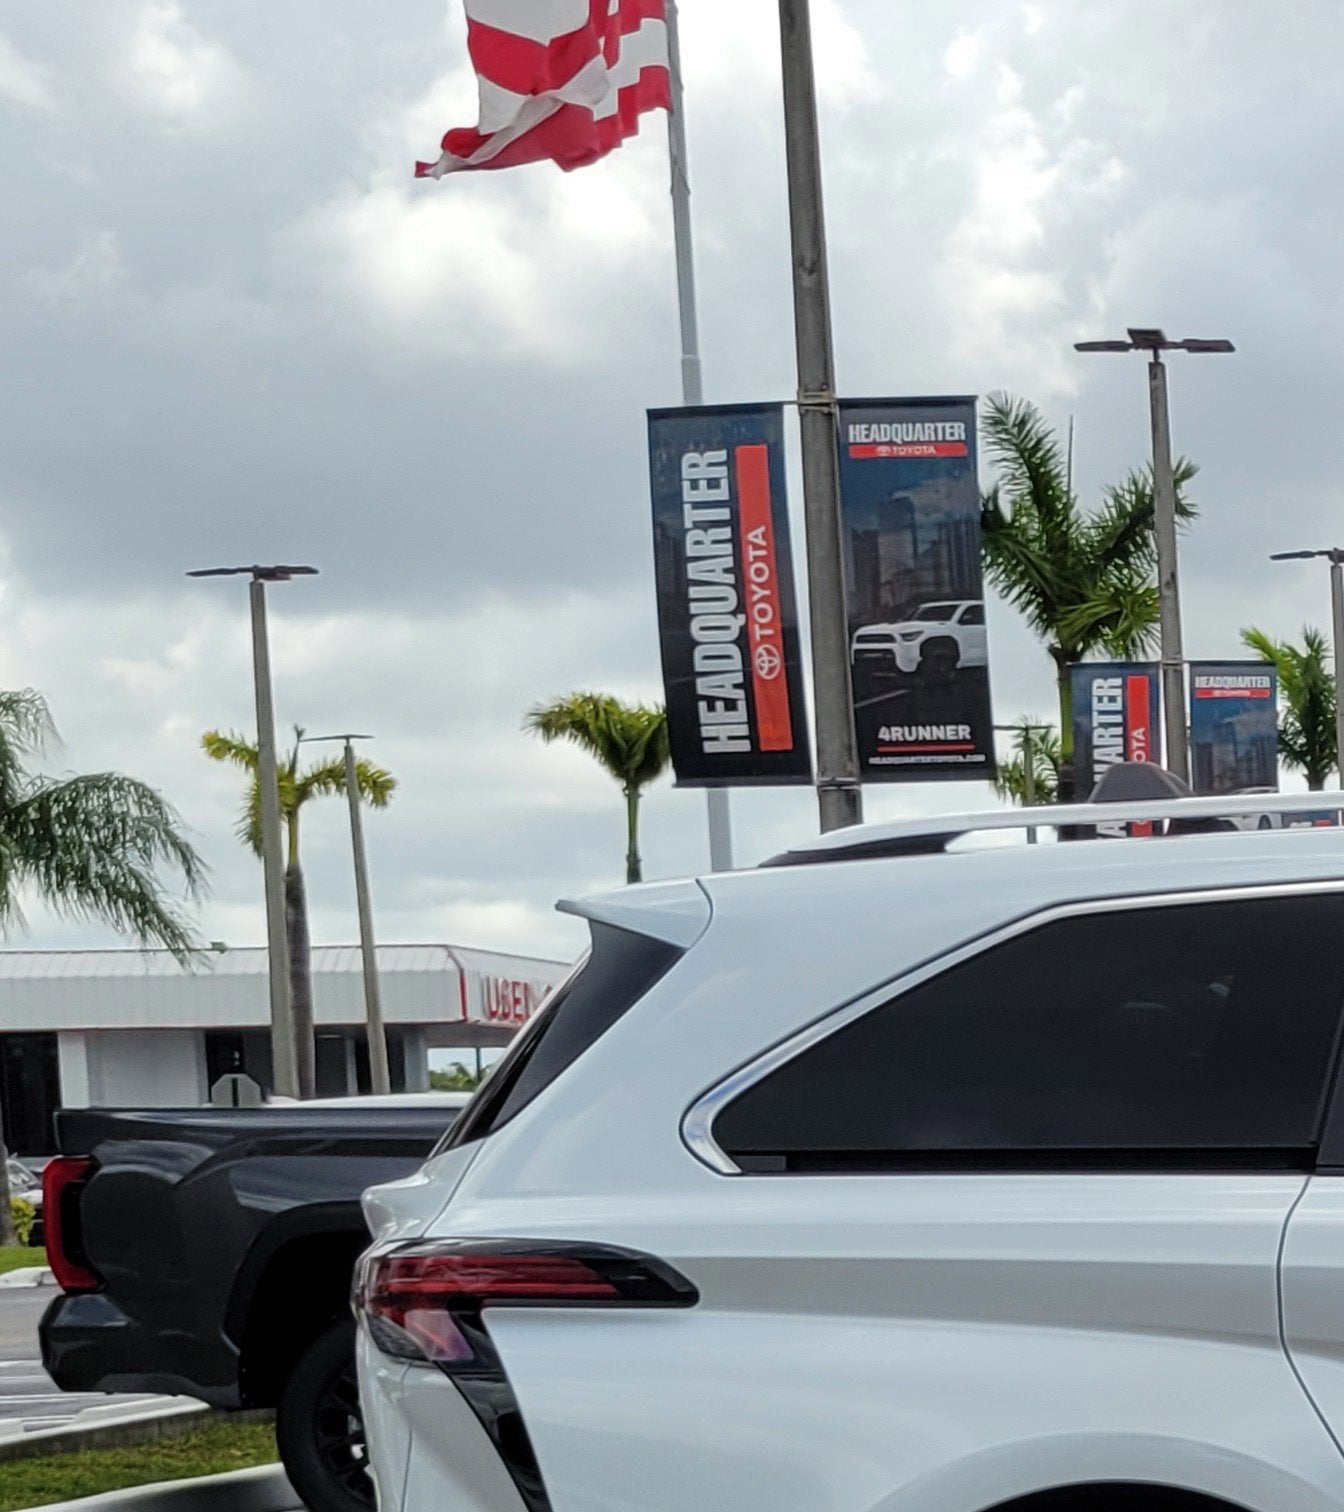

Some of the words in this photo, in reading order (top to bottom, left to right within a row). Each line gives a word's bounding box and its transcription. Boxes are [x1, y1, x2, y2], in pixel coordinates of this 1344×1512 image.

[848, 422, 966, 444] HEADQUARTER
[892, 446, 937, 455] TOYOTA
[746, 526, 775, 641] TOYOTA
[681, 448, 752, 754] HEADQUARTER
[877, 724, 972, 742] 4RUNNER
